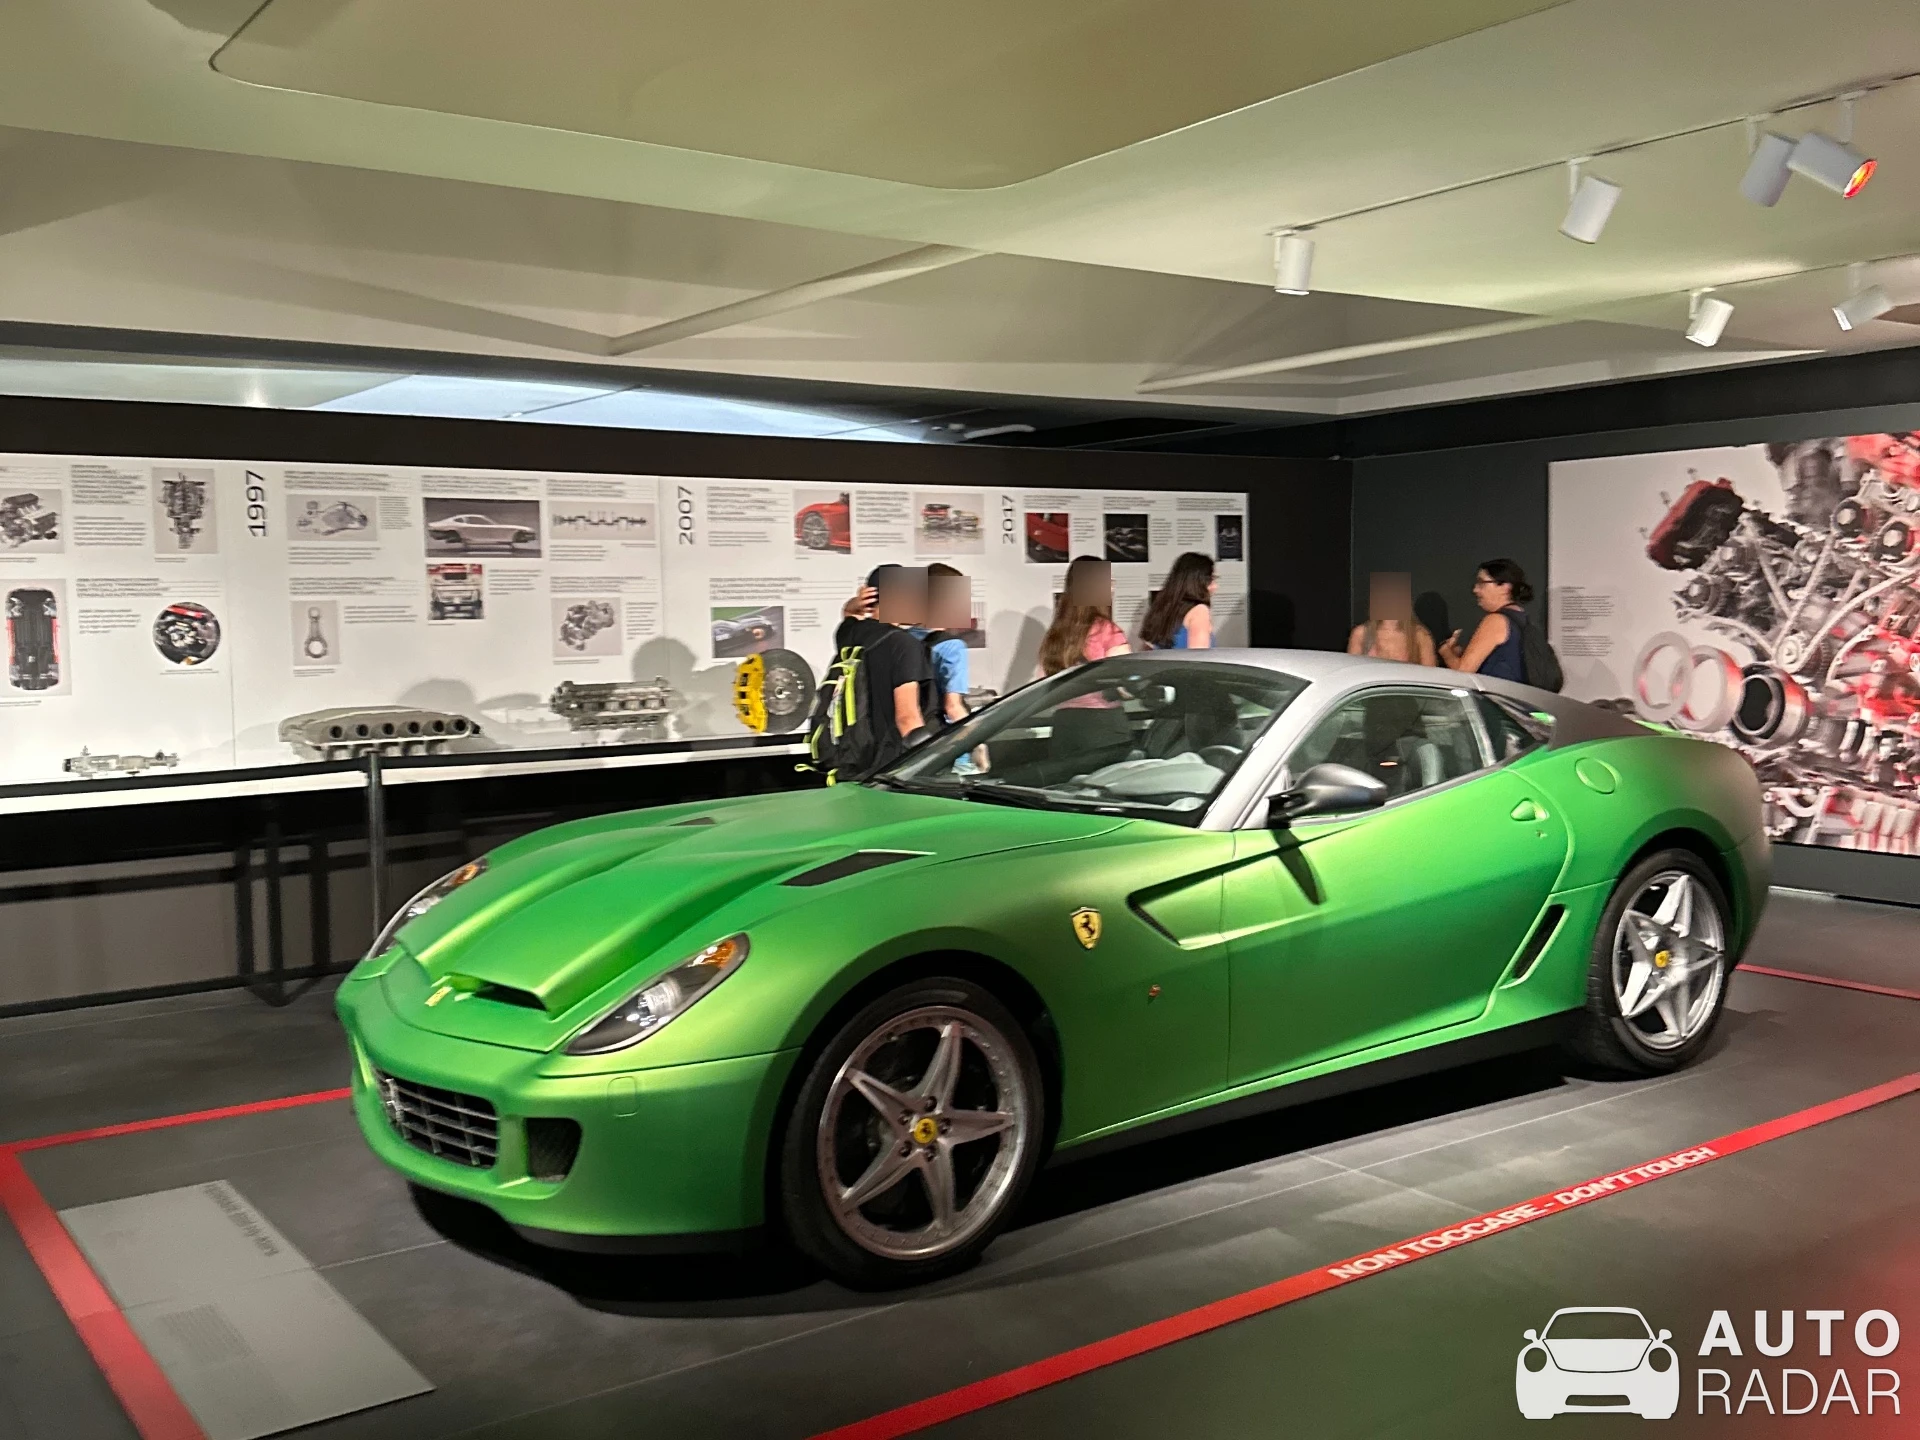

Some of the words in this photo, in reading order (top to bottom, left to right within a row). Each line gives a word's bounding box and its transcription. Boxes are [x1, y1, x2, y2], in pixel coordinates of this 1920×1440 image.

[245, 470, 267, 537] 1997
[678, 486, 693, 545] 2007
[1002, 495, 1014, 544] 2017
[1327, 1249, 1410, 1279] NON
[1397, 1204, 1547, 1254] TOCCARE
[1553, 1173, 1633, 1205] DON'T
[1628, 1147, 1719, 1178] TOUCH
